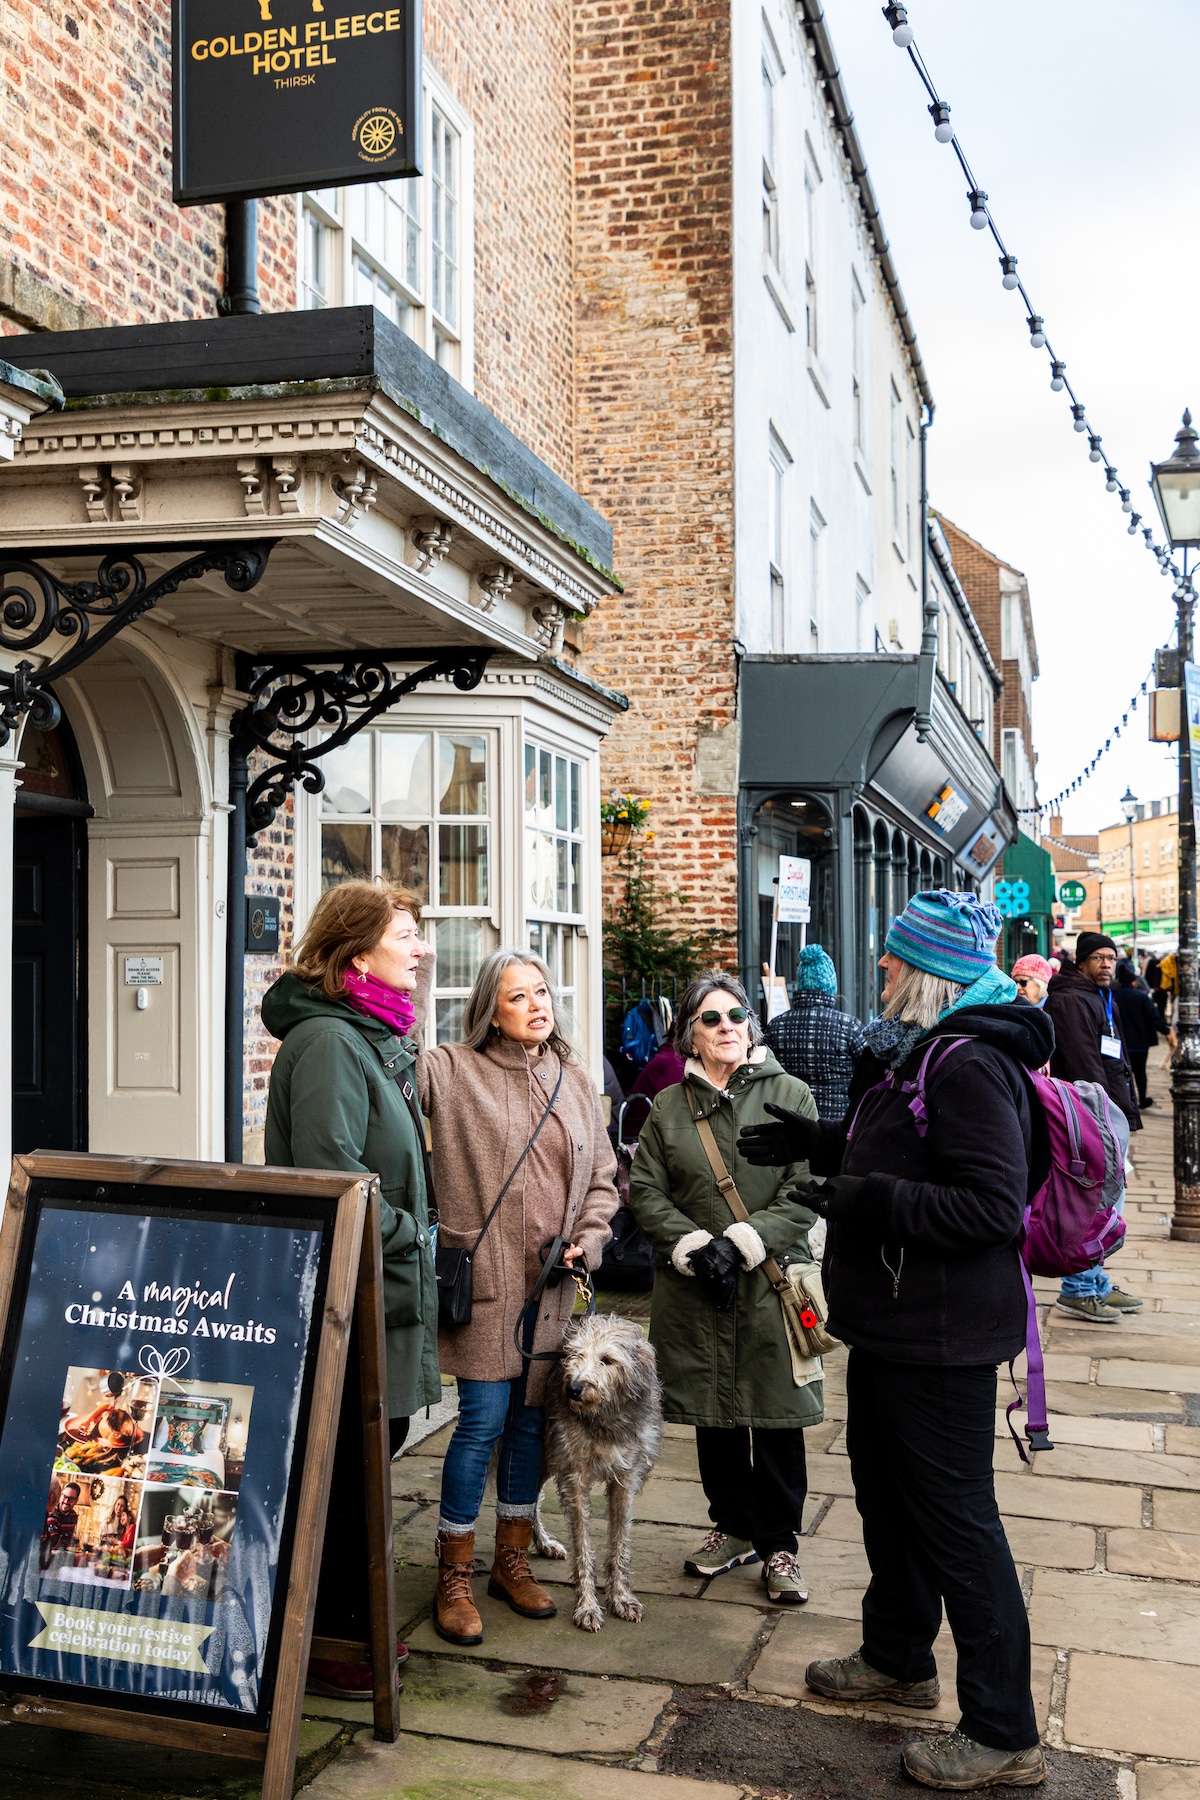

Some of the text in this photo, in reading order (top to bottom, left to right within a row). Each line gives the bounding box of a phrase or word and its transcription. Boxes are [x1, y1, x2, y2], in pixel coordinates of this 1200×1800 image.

[191, 9, 401, 61] GOLDEN FLEECE
[253, 44, 336, 75] HOTEL
[274, 74, 316, 90] THIRSK
[396, 116, 404, 134] HEART
[117, 1272, 236, 1317] A magical
[64, 1303, 277, 1345] Christmas Awaits
[53, 1612, 192, 1646] Book your festive
[49, 1629, 192, 1665] celebration today
